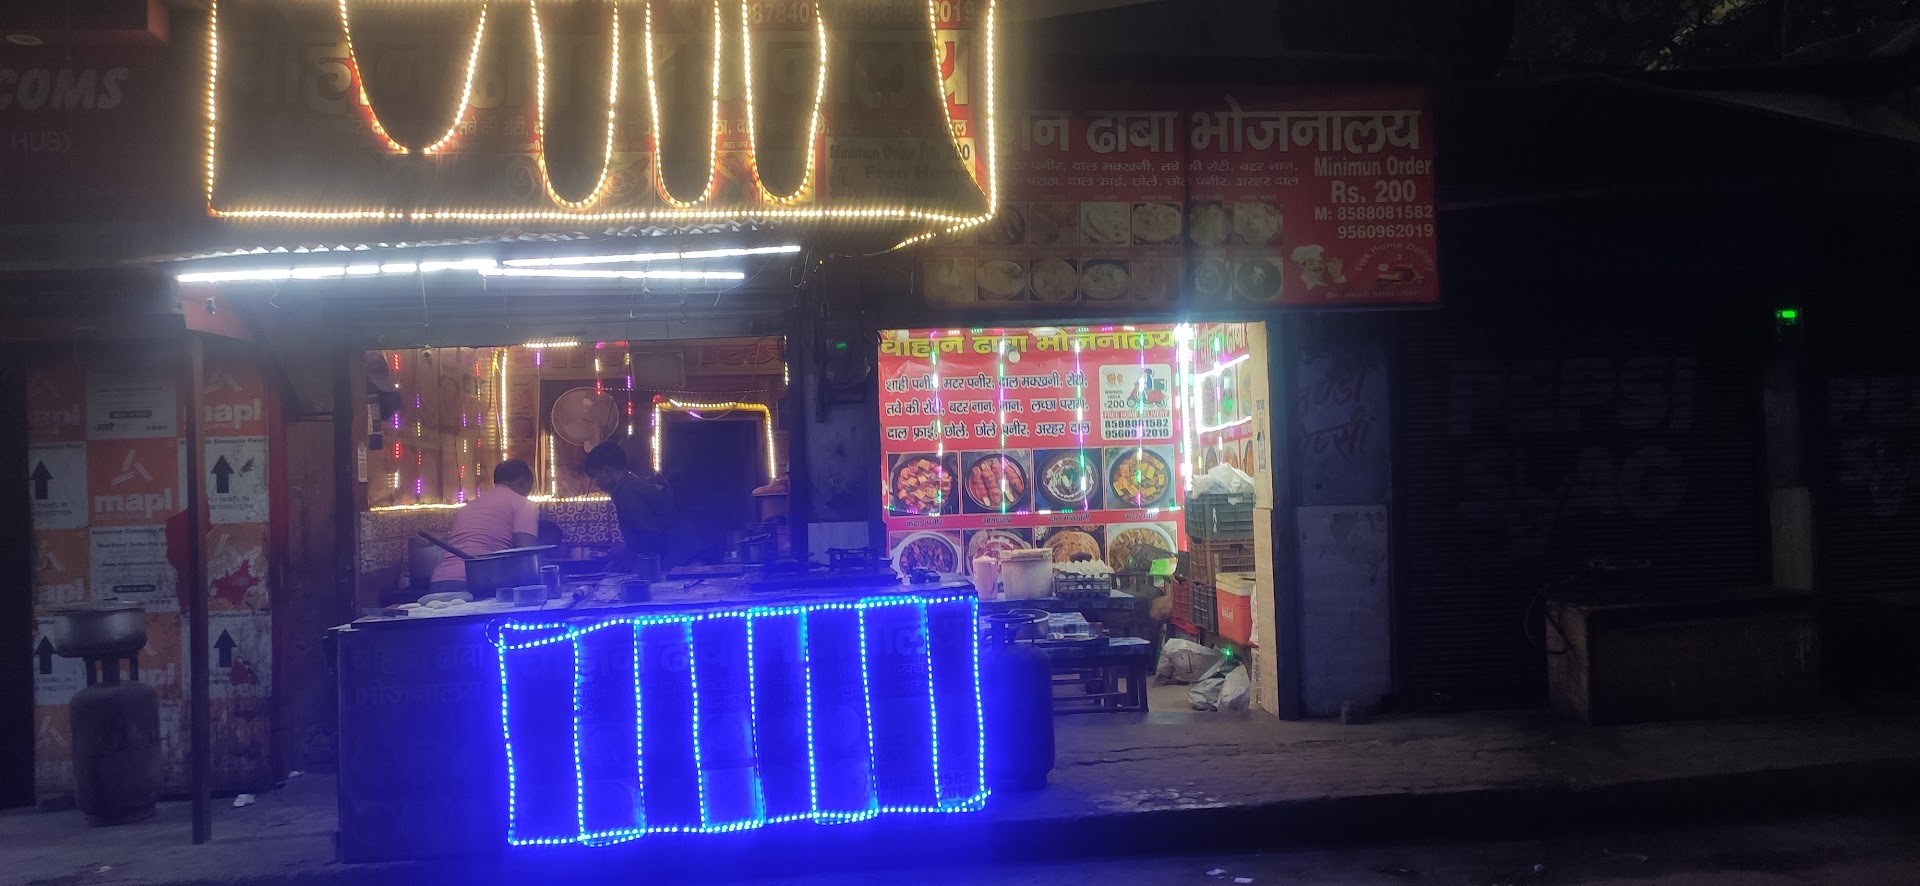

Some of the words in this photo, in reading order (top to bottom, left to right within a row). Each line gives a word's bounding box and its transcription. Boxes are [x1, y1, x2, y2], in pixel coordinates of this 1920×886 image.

[1085, 110, 1179, 154] ढाबा
[1190, 93, 1422, 154] भोजनालय
[1386, 155, 1432, 176] Order
[1234, 176, 1271, 187] अरहर
[1275, 175, 1300, 187] दाल
[1331, 181, 1367, 204] Rs.
[1375, 180, 1416, 202] 200
[1314, 207, 1333, 221] M:
[1337, 204, 1434, 221] 8588081582
[1337, 223, 1434, 239] 9560962019
[943, 375, 965, 390] मटर
[905, 399, 920, 414] की
[948, 400, 969, 413] बटर
[887, 426, 908, 440] दाल
[974, 420, 997, 438] छोले
[1035, 422, 1066, 436] अरहर
[95, 488, 172, 519] mapl
